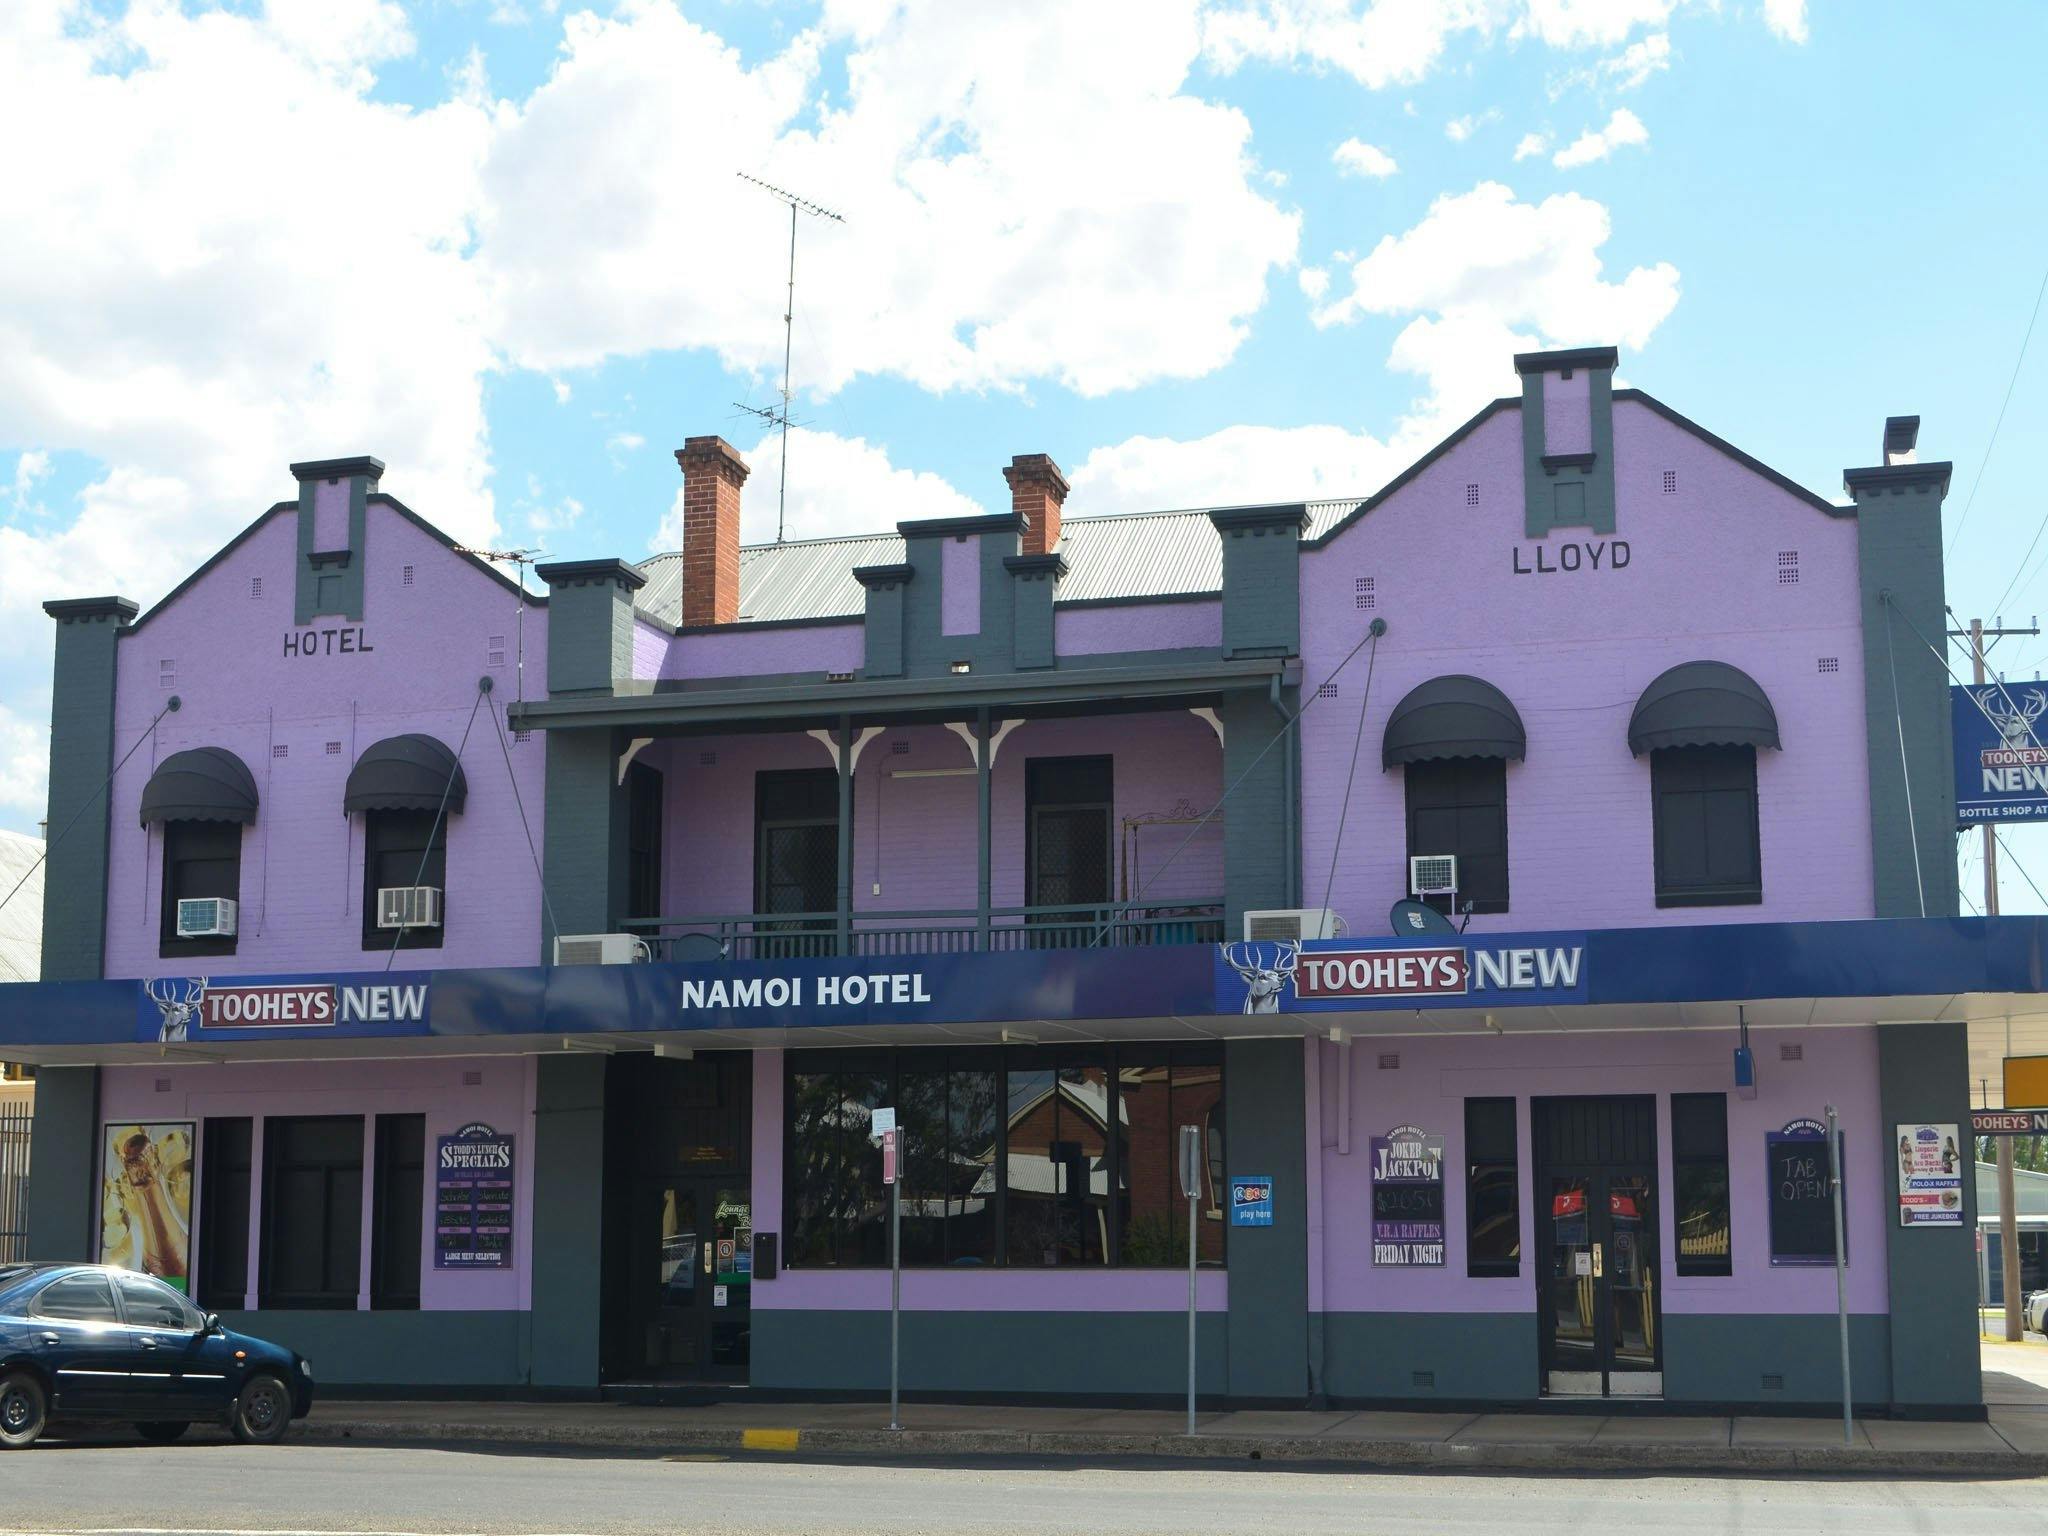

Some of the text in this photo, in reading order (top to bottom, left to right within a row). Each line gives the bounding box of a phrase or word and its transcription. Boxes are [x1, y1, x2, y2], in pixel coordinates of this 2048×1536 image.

[1513, 541, 1630, 574] LLOYD
[284, 628, 374, 657] HOTEL
[1985, 751, 2048, 764] TOOHEYS
[1982, 767, 2048, 792] NEW
[1960, 806, 2048, 817] BOTTLE SHOP AT
[1303, 947, 1584, 991] TOOHEYS NEW
[682, 973, 931, 1008] NAMOI HOTEL
[207, 985, 427, 1021] TOOHEYS NEW
[1783, 1120, 1826, 1136] NAMOI HOTEL
[1972, 1115, 2029, 1129] OOHEYS
[1387, 1126, 1427, 1140] NAMOI HOTEL
[441, 1145, 510, 1168] SPECIALS
[454, 1144, 499, 1154] TODD'S LUNCH
[1390, 1142, 1422, 1158] JOKER
[1374, 1148, 1441, 1180] JACKPOT
[1782, 1156, 1816, 1178] TAB
[1235, 1187, 1269, 1200] KENO
[715, 1201, 750, 1218] Lounge
[1240, 1209, 1271, 1220] play here
[1930, 1212, 1959, 1220] JUKEBOX
[1401, 1224, 1441, 1238] RAFFLES
[1374, 1244, 1443, 1264] FRIDAY NIGHT
